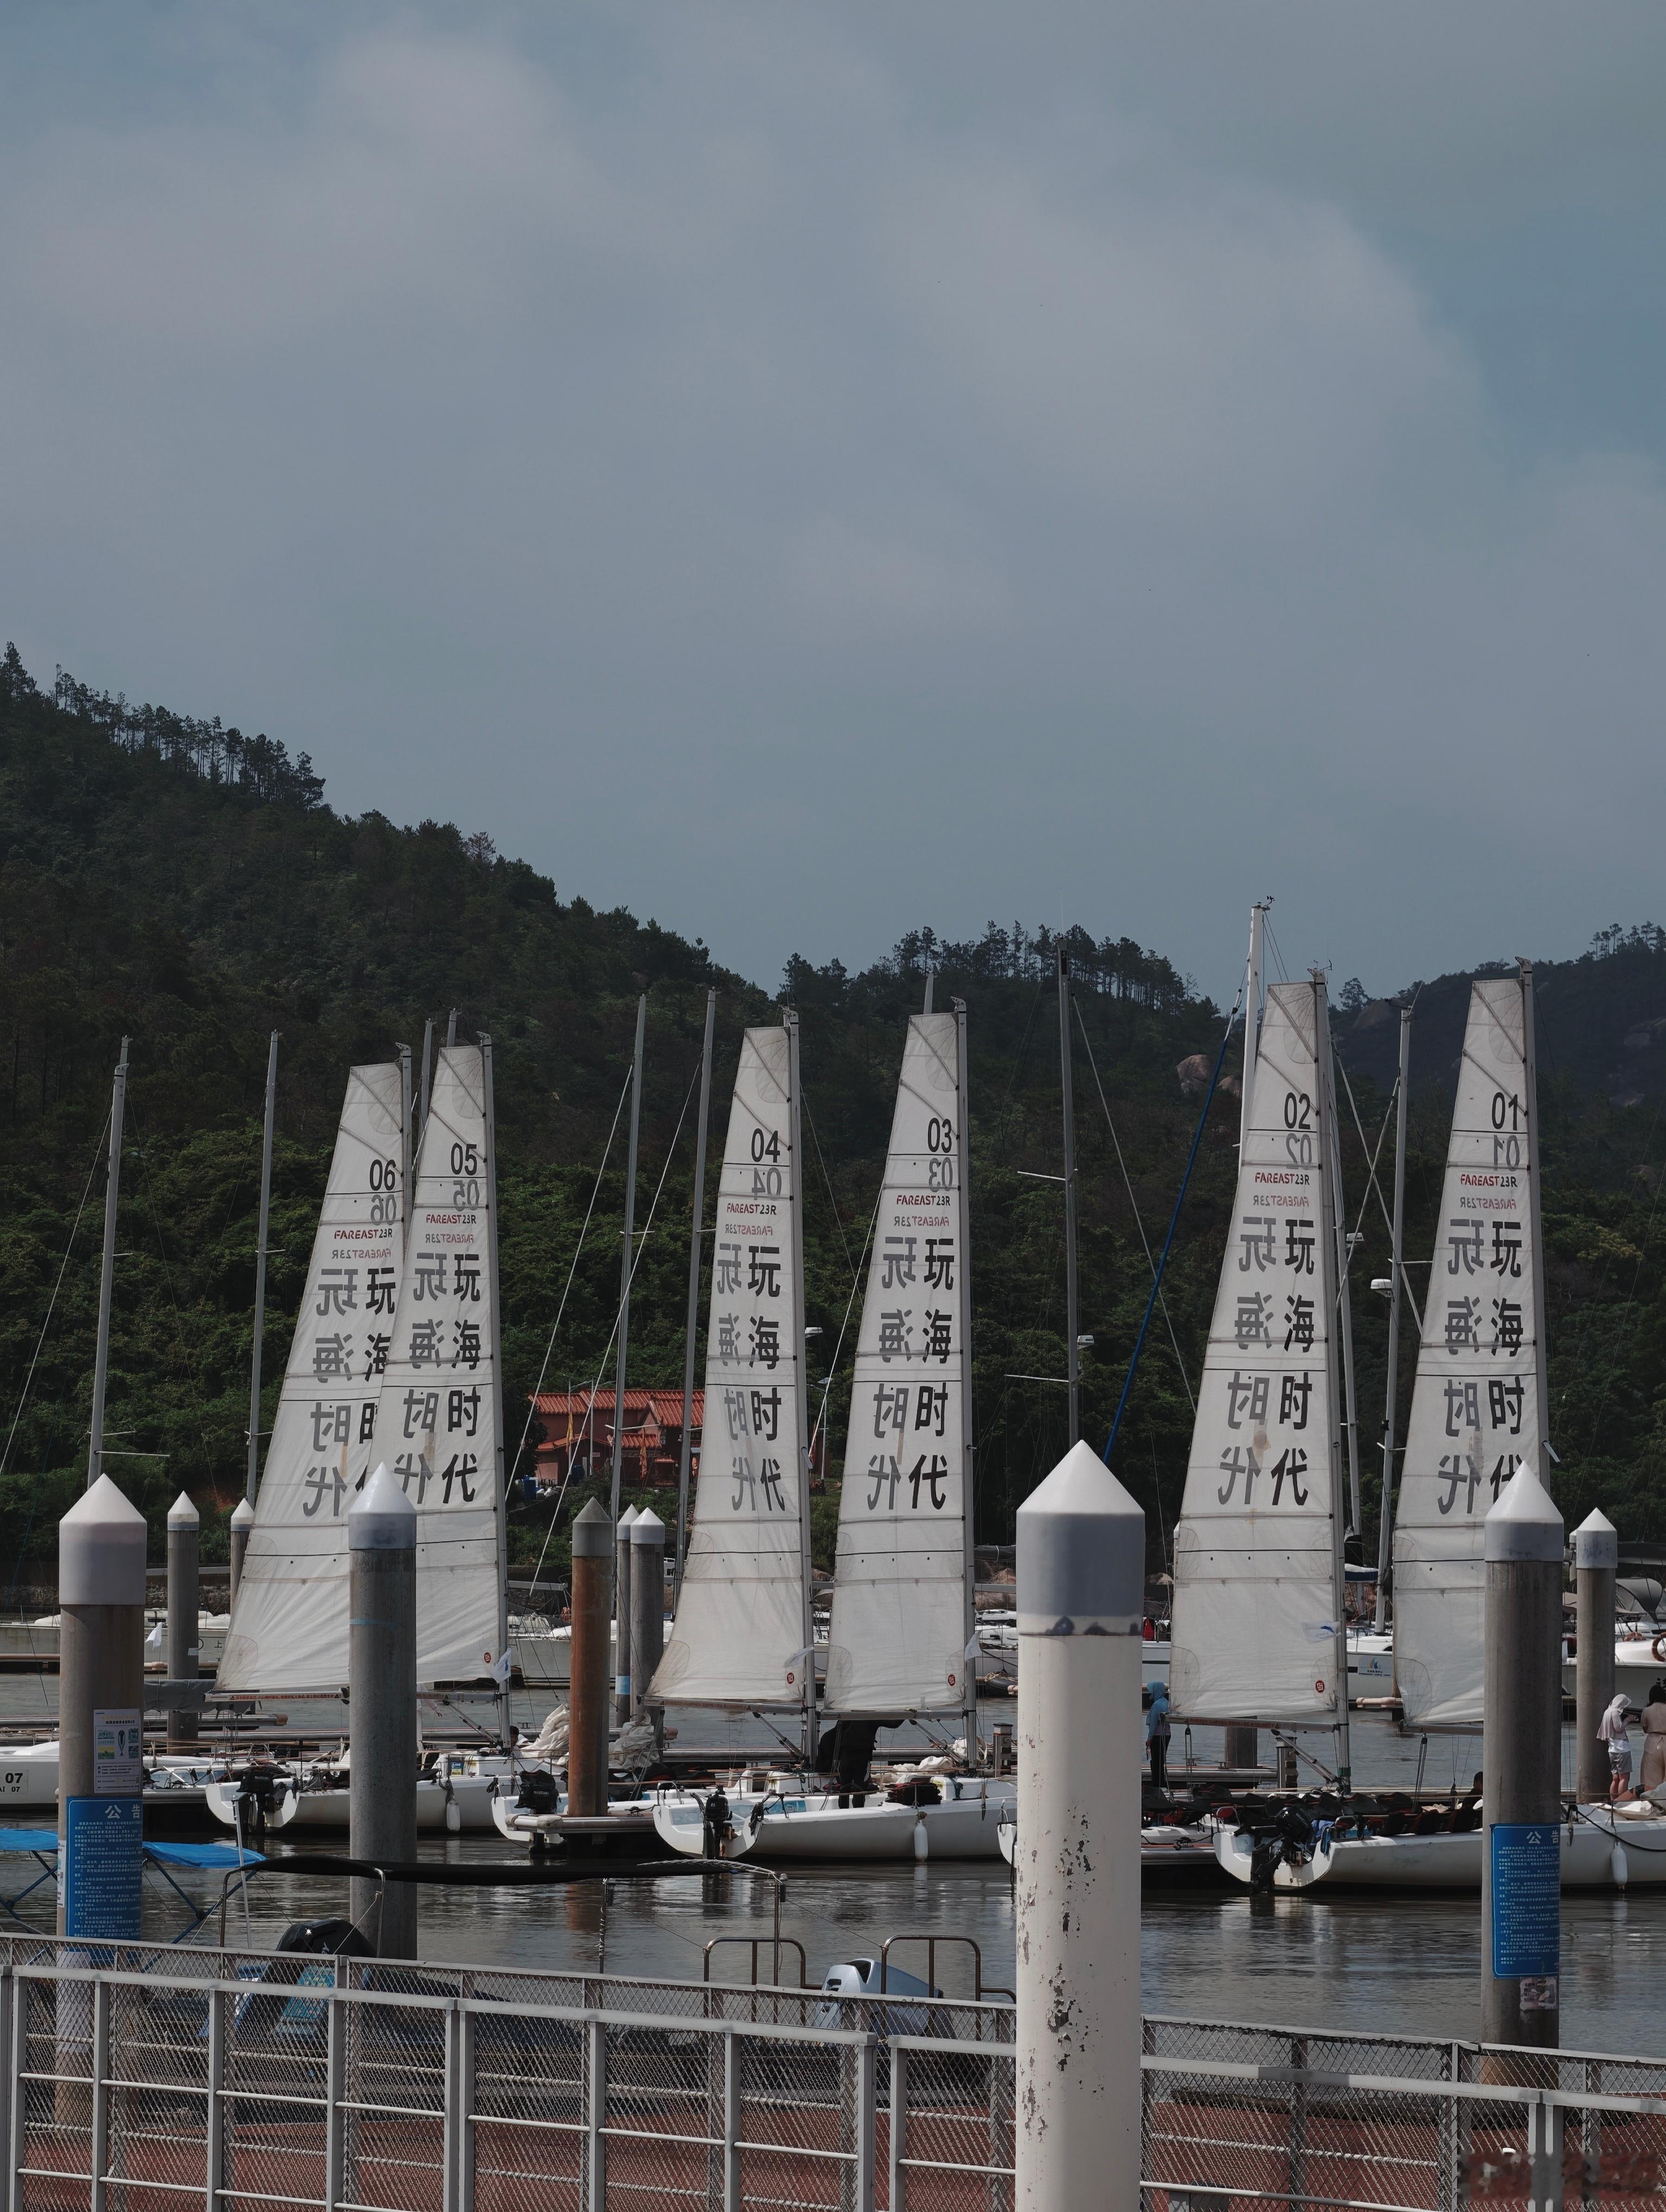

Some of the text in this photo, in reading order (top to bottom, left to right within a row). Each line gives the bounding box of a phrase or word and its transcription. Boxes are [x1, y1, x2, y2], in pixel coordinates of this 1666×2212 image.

[1284, 1092, 1310, 1129] 02
[1491, 1092, 1518, 1130] 01
[751, 1128, 780, 1162] 04
[927, 1117, 952, 1153] 03
[369, 1159, 395, 1191] 06
[451, 1142, 477, 1175] 05
[442, 1253, 481, 1504] 玩海时代
[747, 1246, 785, 1511] 玩海时代
[908, 1238, 954, 1509] 玩海时代
[1271, 1219, 1315, 1506] 玩海时代
[5, 1772, 23, 1784] 07
[105, 1804, 140, 1819] 公告
[1526, 1830, 1559, 1844] 公告
